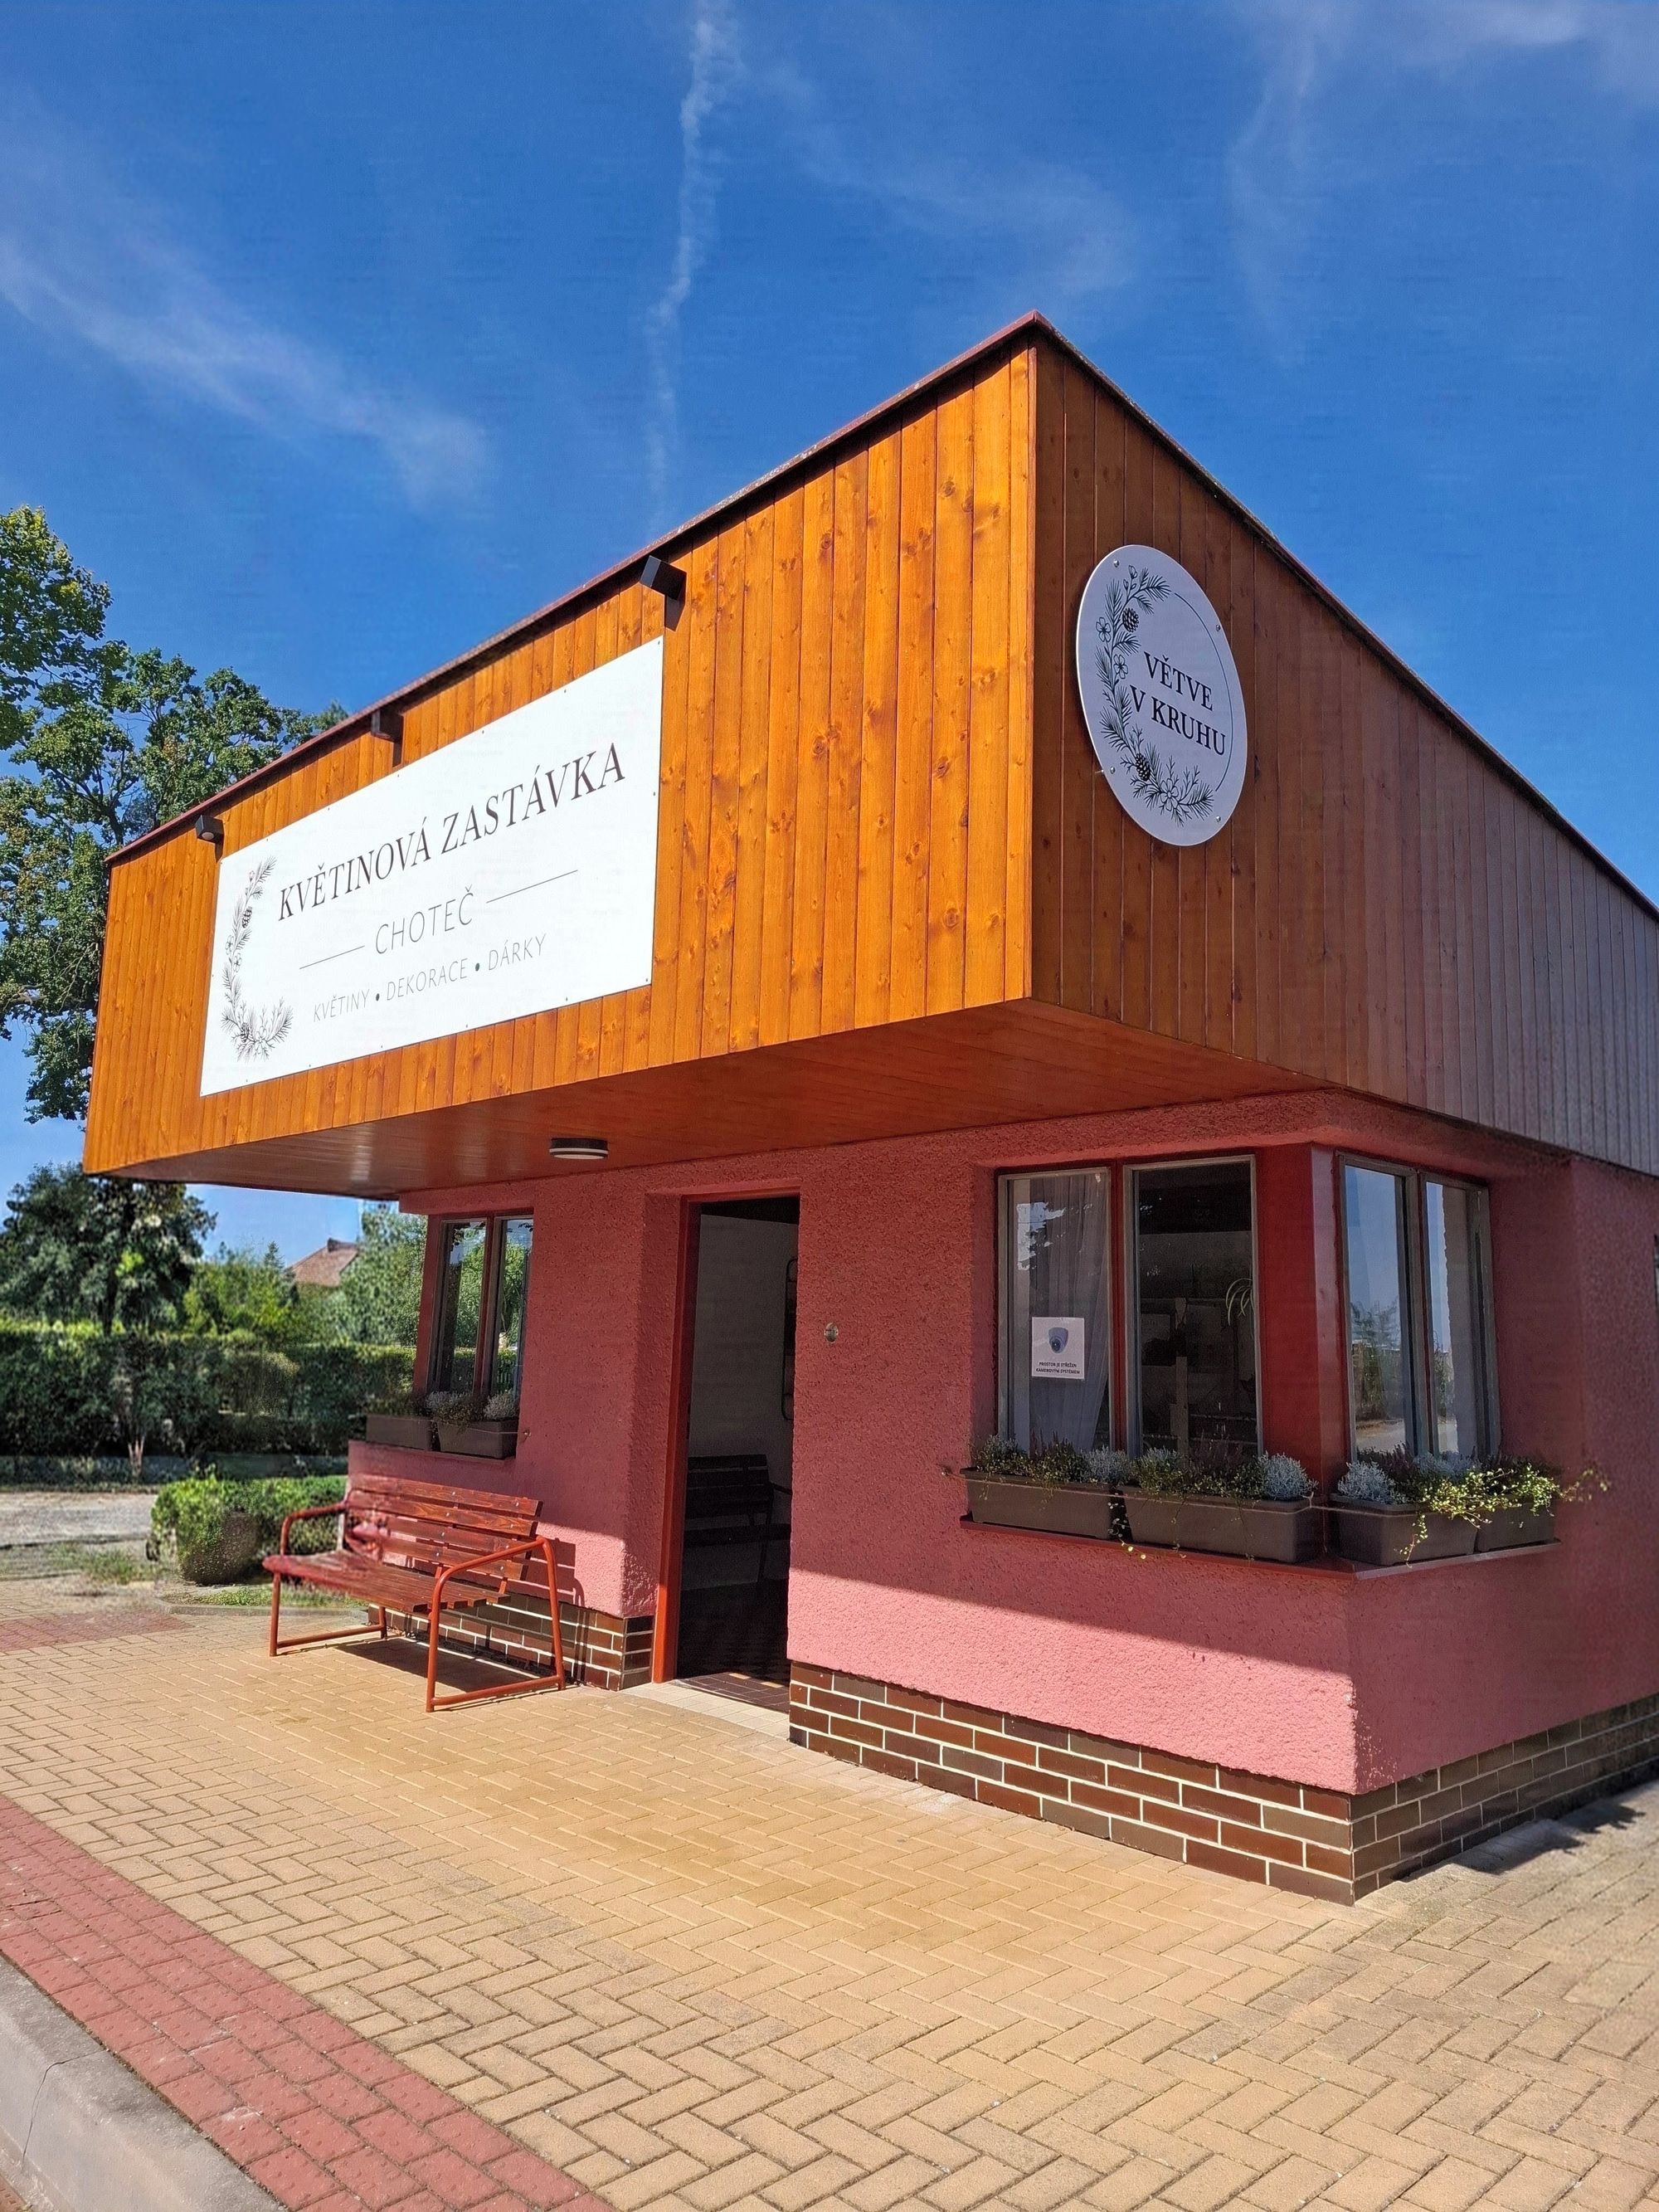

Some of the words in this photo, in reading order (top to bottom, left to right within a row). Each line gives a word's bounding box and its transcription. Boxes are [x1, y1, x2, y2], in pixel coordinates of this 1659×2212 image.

[1144, 651, 1213, 711] VĚTVE
[1130, 685, 1146, 713] V
[1151, 697, 1226, 756] KRUHU
[279, 816, 431, 921] KVĚTINOVÁ
[441, 743, 625, 854] ZASTÁVKA
[376, 884, 474, 955] CHOTEČ
[314, 988, 370, 1023] KVĚTINY
[387, 957, 468, 1001] DEKORACE
[488, 933, 547, 971] DÁRKY
